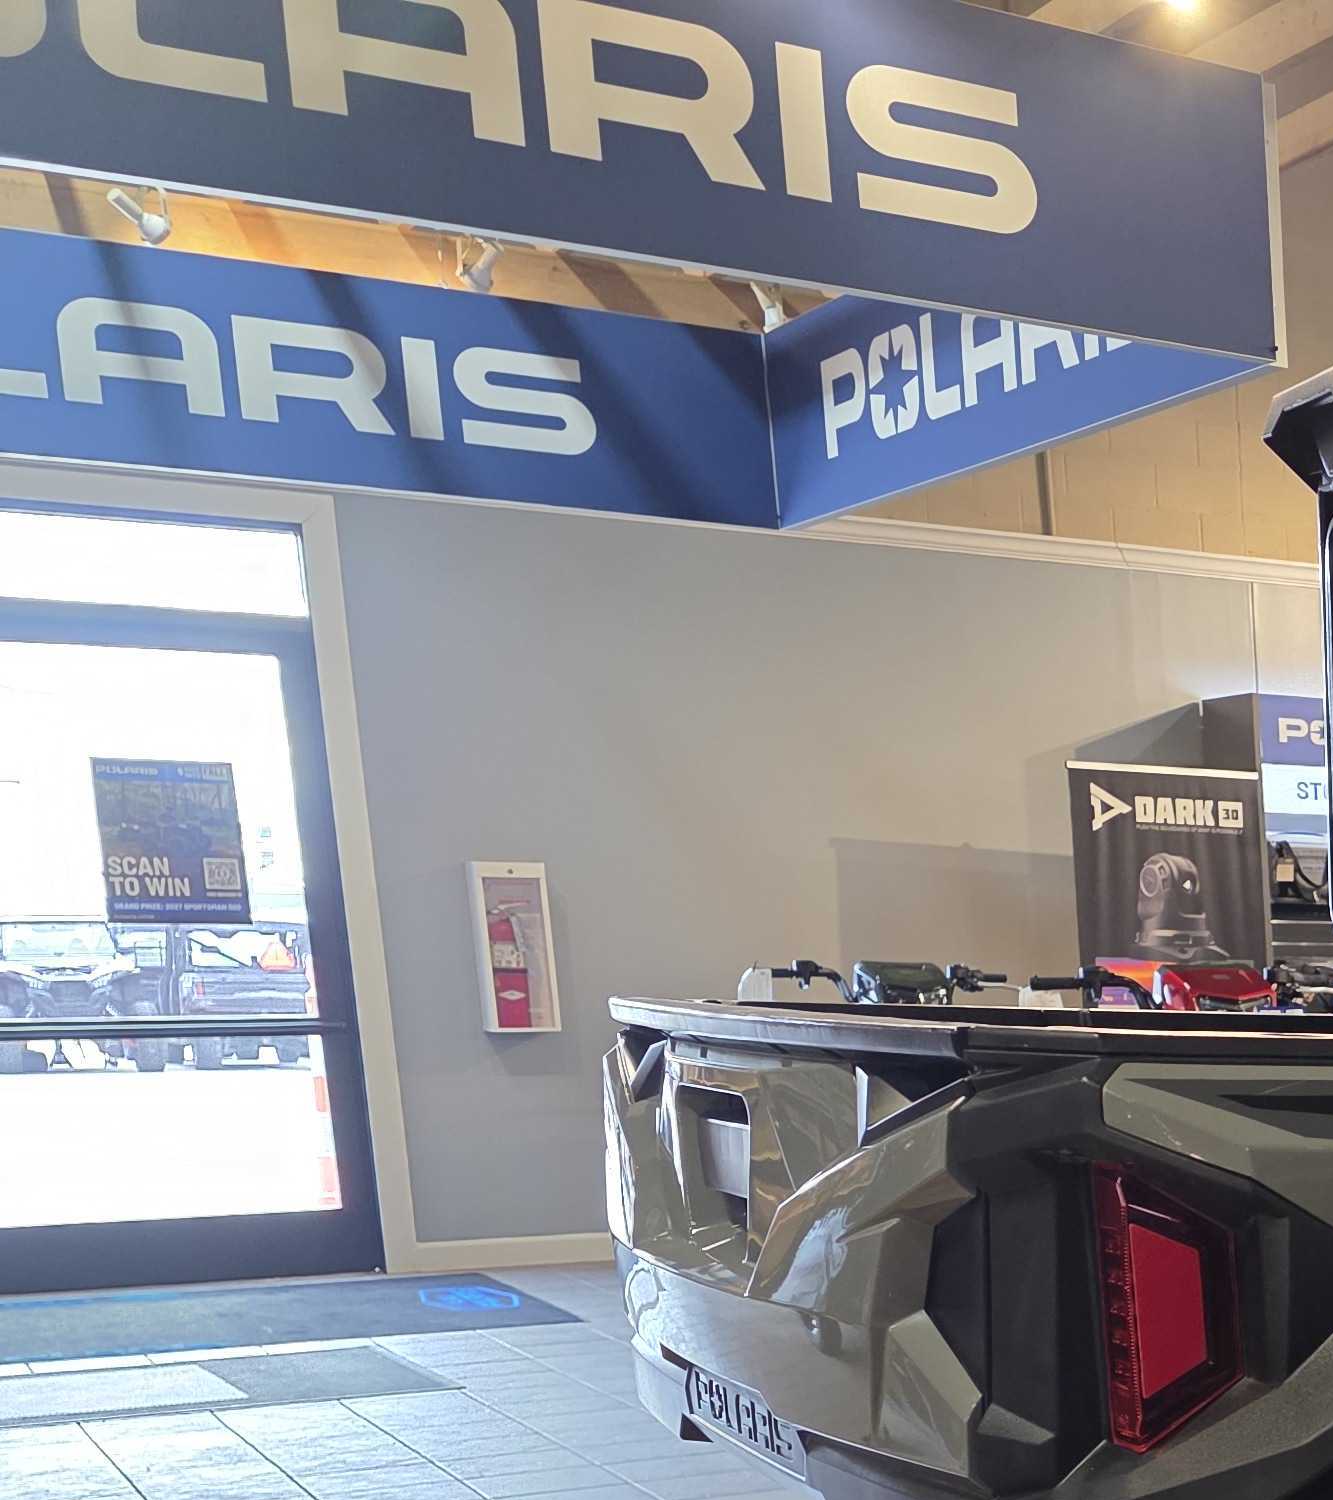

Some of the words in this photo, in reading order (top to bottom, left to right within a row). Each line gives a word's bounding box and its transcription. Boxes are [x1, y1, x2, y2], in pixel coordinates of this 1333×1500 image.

[0, 0, 1038, 234] LARIS
[0, 297, 597, 456] ARIS
[1134, 795, 1217, 827] DARK
[107, 856, 170, 876] SCAN
[109, 876, 141, 897] TO
[144, 877, 191, 897] WIN
[694, 1369, 794, 1462] POLARIS
